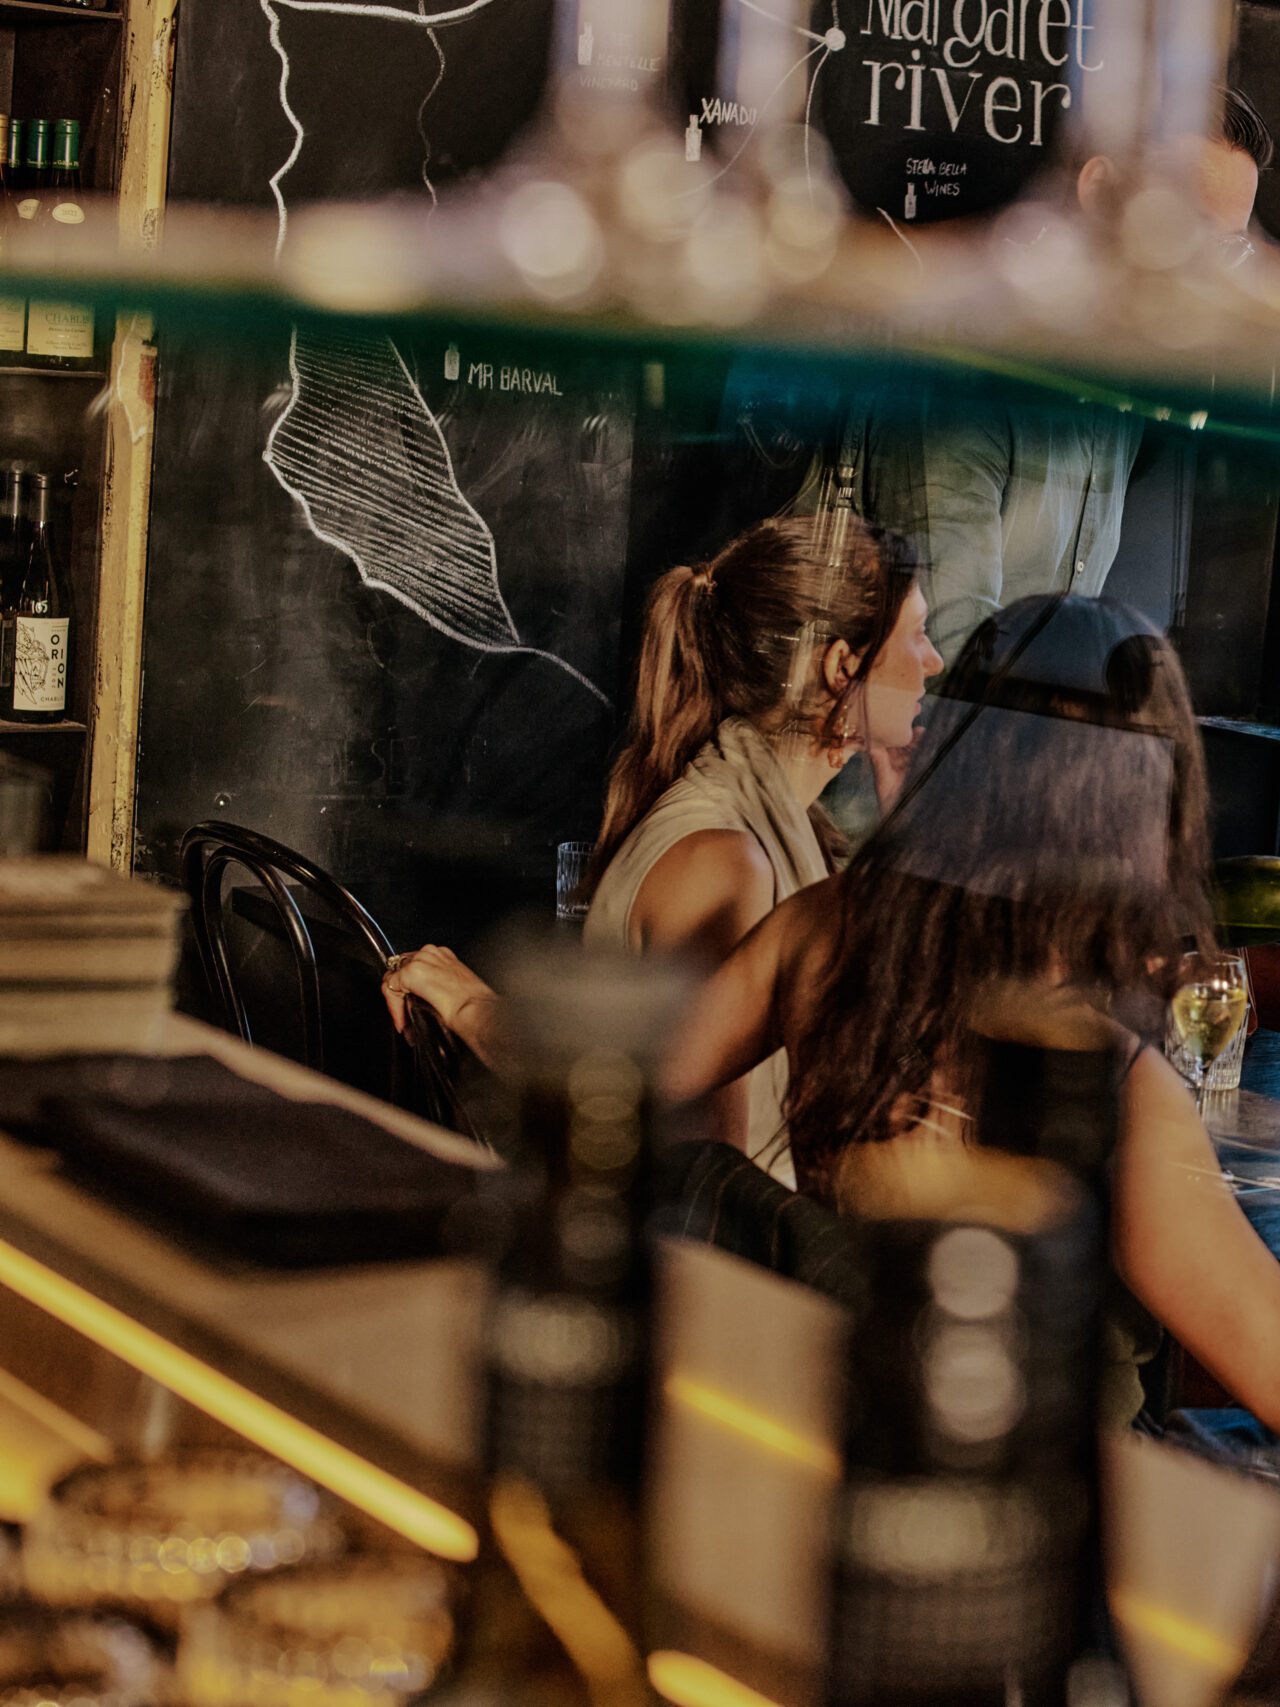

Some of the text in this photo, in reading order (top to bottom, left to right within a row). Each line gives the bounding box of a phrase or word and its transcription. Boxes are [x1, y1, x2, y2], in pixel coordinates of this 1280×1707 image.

[860, 0, 1103, 71] Margaret
[699, 97, 758, 126] XANADU
[862, 49, 1072, 146] river
[938, 161, 968, 177] BELLA
[924, 180, 961, 197] WINES
[468, 362, 563, 396] MR BARVAL
